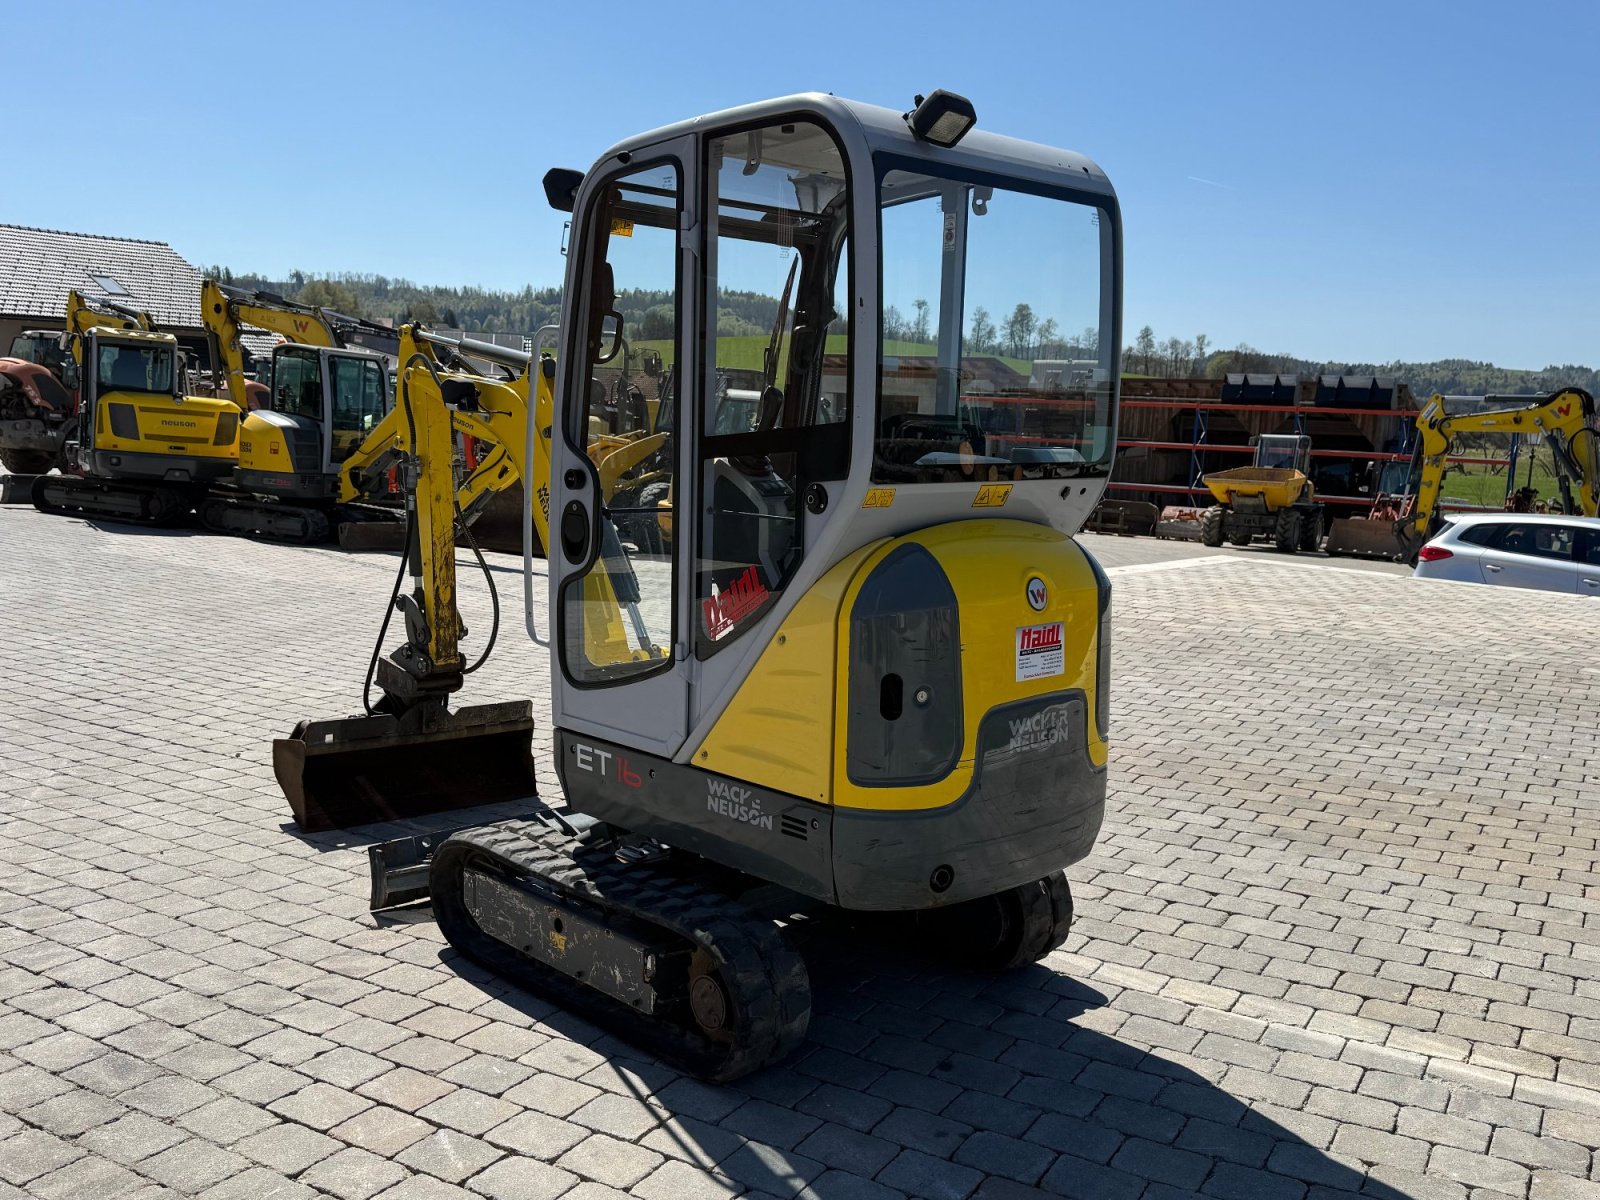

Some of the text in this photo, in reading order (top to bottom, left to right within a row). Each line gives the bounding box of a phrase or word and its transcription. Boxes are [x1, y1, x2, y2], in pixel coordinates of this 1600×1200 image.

[161, 419, 197, 428] neuson
[703, 564, 766, 631] Haidl
[1020, 624, 1061, 650] Haidl
[576, 743, 642, 788] ET 16
[707, 795, 773, 831] NEUSON
